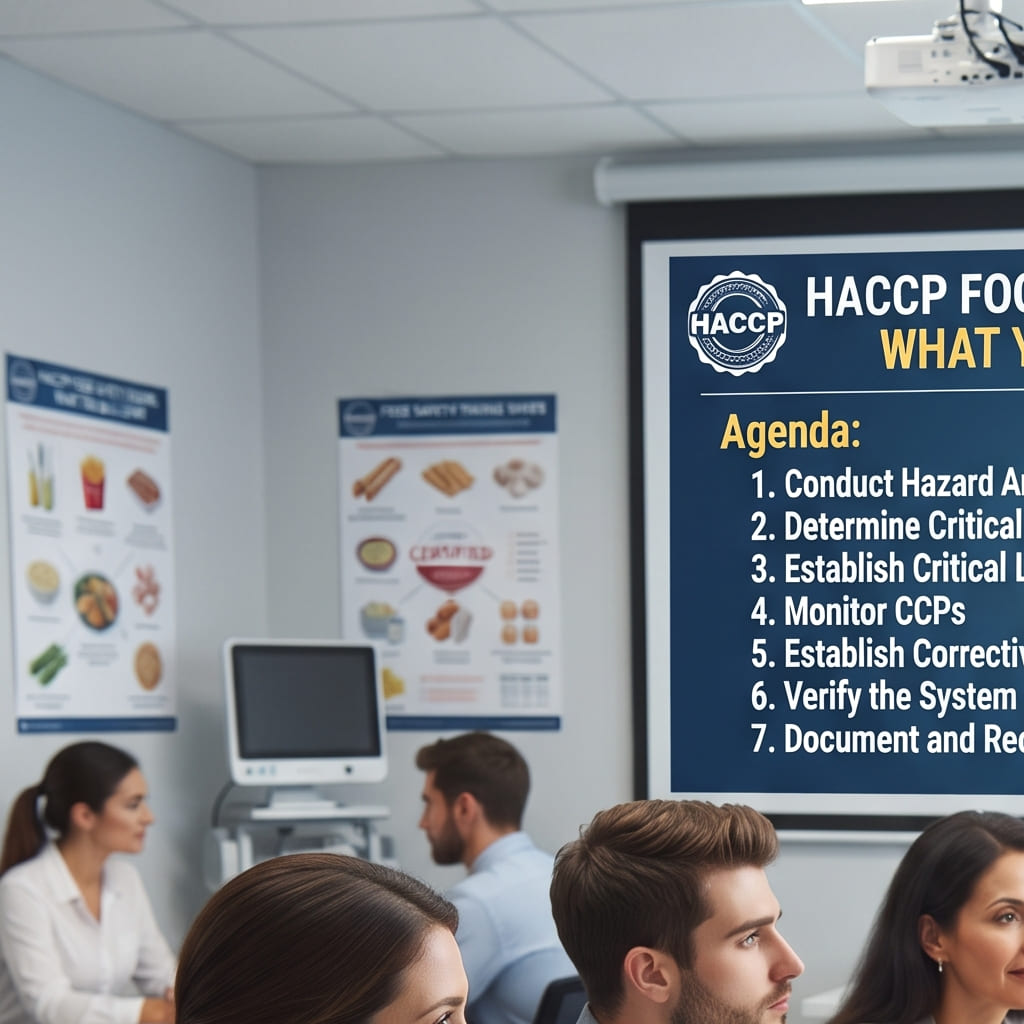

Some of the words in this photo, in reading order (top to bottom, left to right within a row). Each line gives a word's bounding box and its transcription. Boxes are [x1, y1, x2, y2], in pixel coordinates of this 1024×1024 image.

[807, 275, 947, 317] HACCP
[691, 312, 784, 335] HACCP
[879, 327, 1001, 370] WHAT
[720, 410, 860, 458] Agenda:
[751, 470, 775, 499] 1.
[785, 467, 894, 499] Conduct
[901, 466, 994, 498] Hazard
[751, 511, 776, 541] 2.
[785, 509, 921, 541] Determine
[928, 508, 1022, 540] Critical
[751, 554, 776, 584] 3.
[785, 552, 905, 584] Establish
[913, 551, 1007, 583] Critical
[750, 596, 776, 626] 4.
[785, 594, 888, 626] Monitor
[895, 595, 966, 626] CCPs
[751, 638, 776, 668] 5.
[785, 636, 905, 668] Establish
[751, 680, 776, 711] 6.
[784, 679, 862, 718] Verify
[868, 679, 912, 711] the
[919, 680, 1017, 718] System
[751, 723, 775, 753] 7.
[785, 722, 920, 754] Document
[926, 722, 975, 754] and
